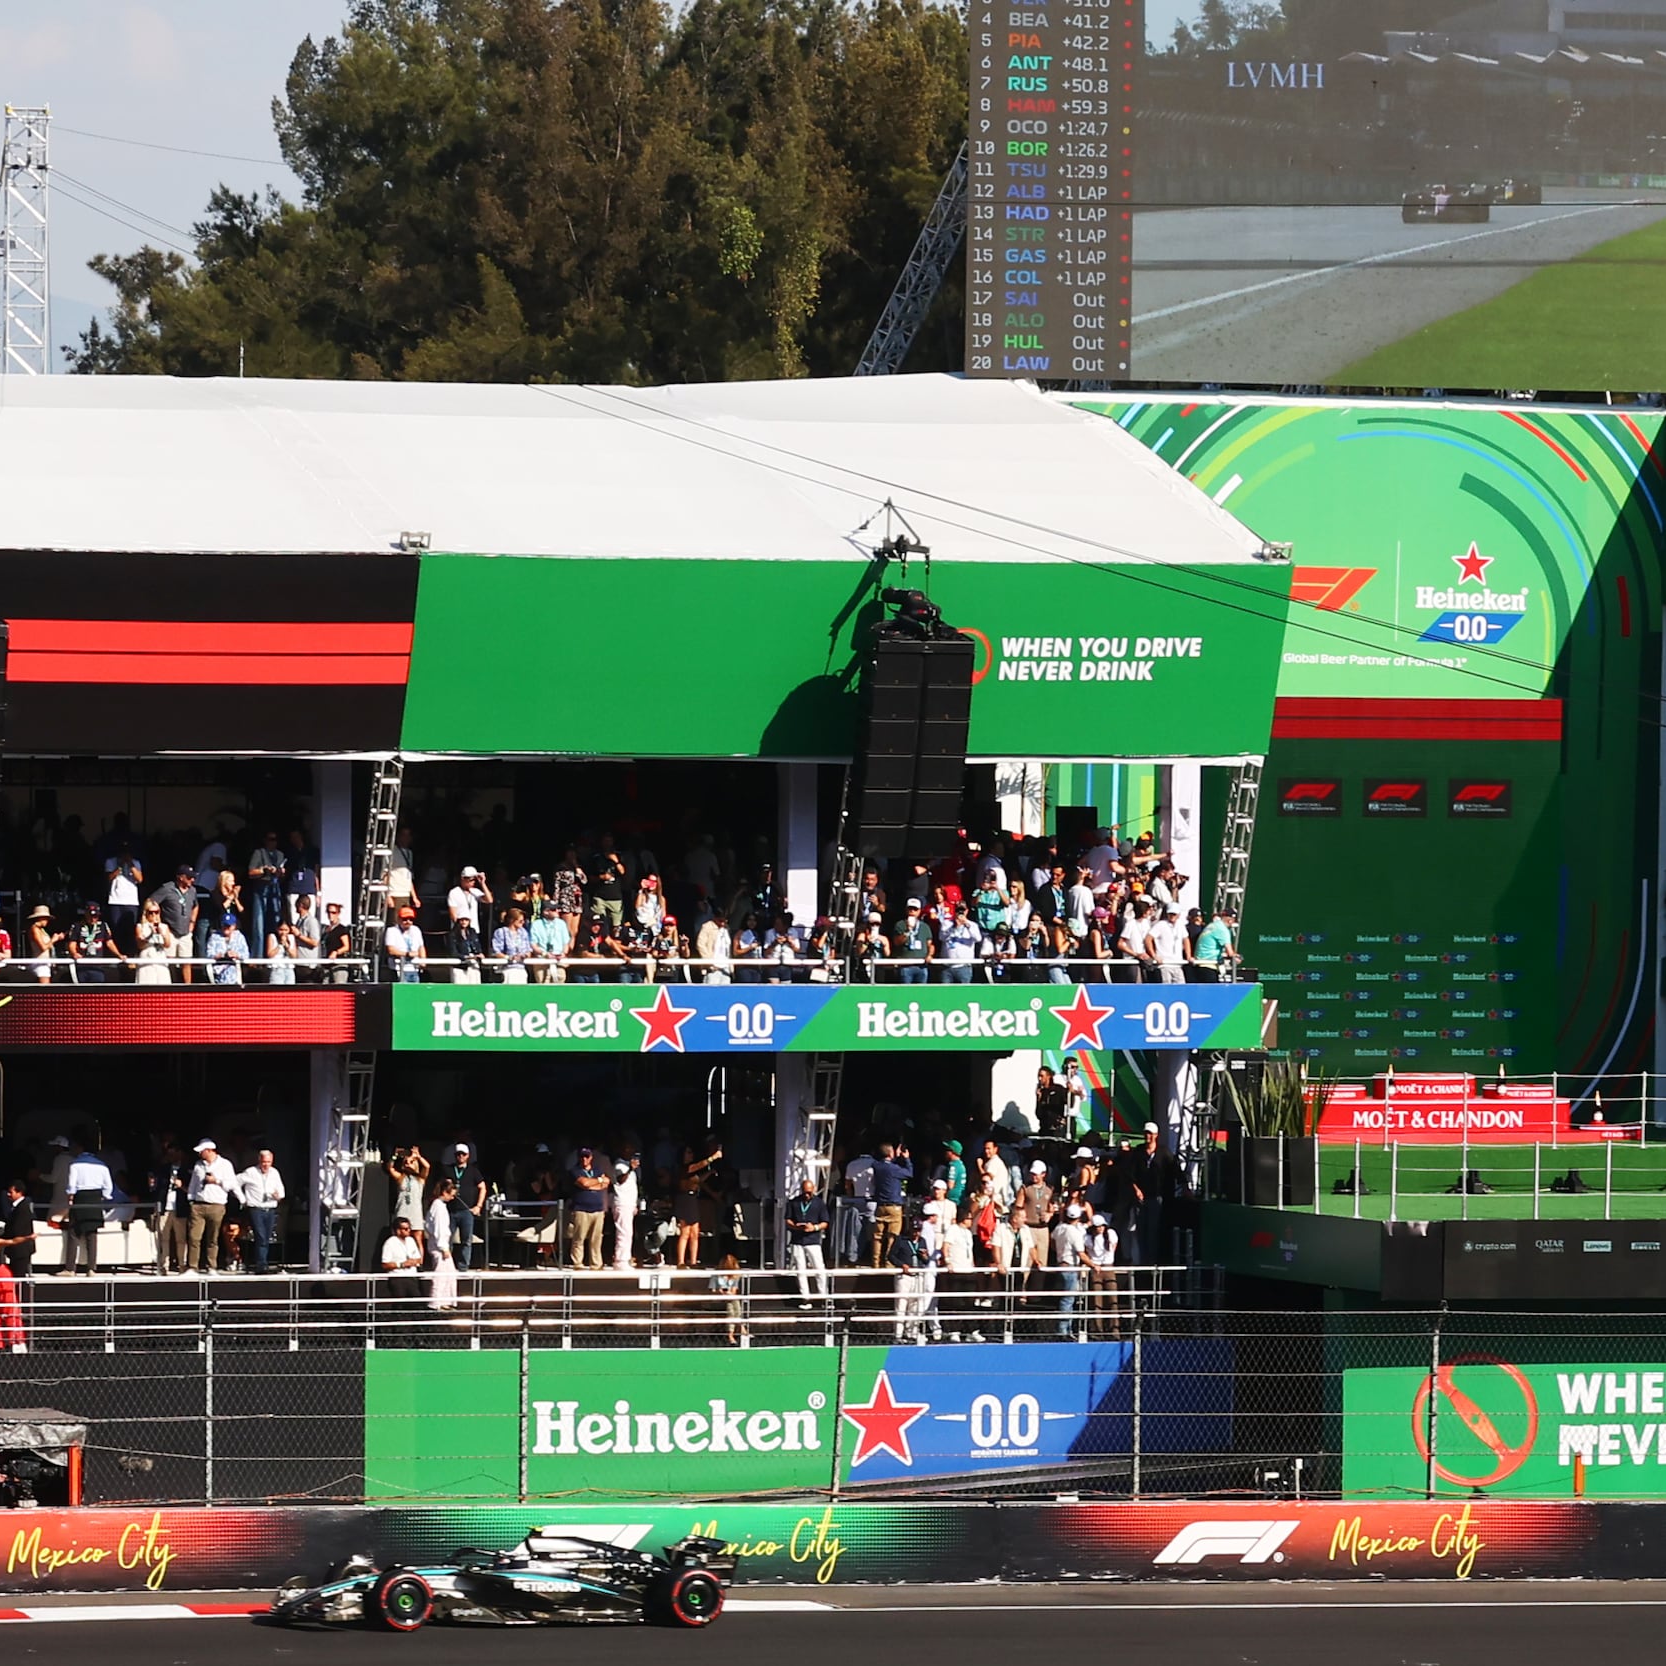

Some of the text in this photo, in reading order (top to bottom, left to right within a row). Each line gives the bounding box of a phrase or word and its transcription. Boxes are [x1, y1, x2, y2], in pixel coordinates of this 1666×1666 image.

[982, 12, 1109, 29] 4 BEA +41.2
[981, 34, 1109, 50] 5 PIA +42.2
[981, 55, 1109, 72] 6 ANT +48.1
[1227, 60, 1325, 88] LVMH
[981, 76, 1109, 93] 7 RUS +50.8
[981, 98, 1107, 114] 8 HAM +59.3
[980, 120, 1109, 136] 9 OCO +1:24.7
[975, 141, 1108, 158] 10 BOR +1:26.2
[975, 162, 1107, 179] 11 TSU +1:29.9
[975, 184, 1107, 200] 12 ALB LAP
[974, 206, 1107, 221] 13 HAD LAP
[973, 227, 1107, 243] 14 STR LAP
[973, 248, 1106, 264] 15 GAS LAP
[973, 270, 1105, 286] 16 COL LAP
[973, 292, 1105, 307] 17 SAI Out
[973, 313, 1105, 328] 18 ALO Out
[972, 334, 1105, 350] 19 HUL Out
[972, 356, 1105, 372] 20 LAW Out
[1415, 586, 1528, 612] Heineken
[1001, 637, 1203, 658] WHEN YOU DRIVE
[1283, 652, 1319, 664] Global
[1321, 654, 1347, 664] Beer
[1349, 654, 1391, 667] Partner
[1393, 656, 1406, 666] of
[999, 661, 1154, 682] NEVER DRINK
[431, 999, 621, 1040] Heineken
[857, 1001, 1041, 1040] Heineken
[1353, 1106, 1524, 1128] MOËT & CHANDON
[1475, 1243, 1517, 1251] crypto.com
[533, 1398, 823, 1456] Heineken
[790, 1506, 847, 1584] City
[1329, 1502, 1485, 1578] Mexico City
[7, 1512, 177, 1590] Mexico City
[515, 1580, 582, 1594] PETRONAS
